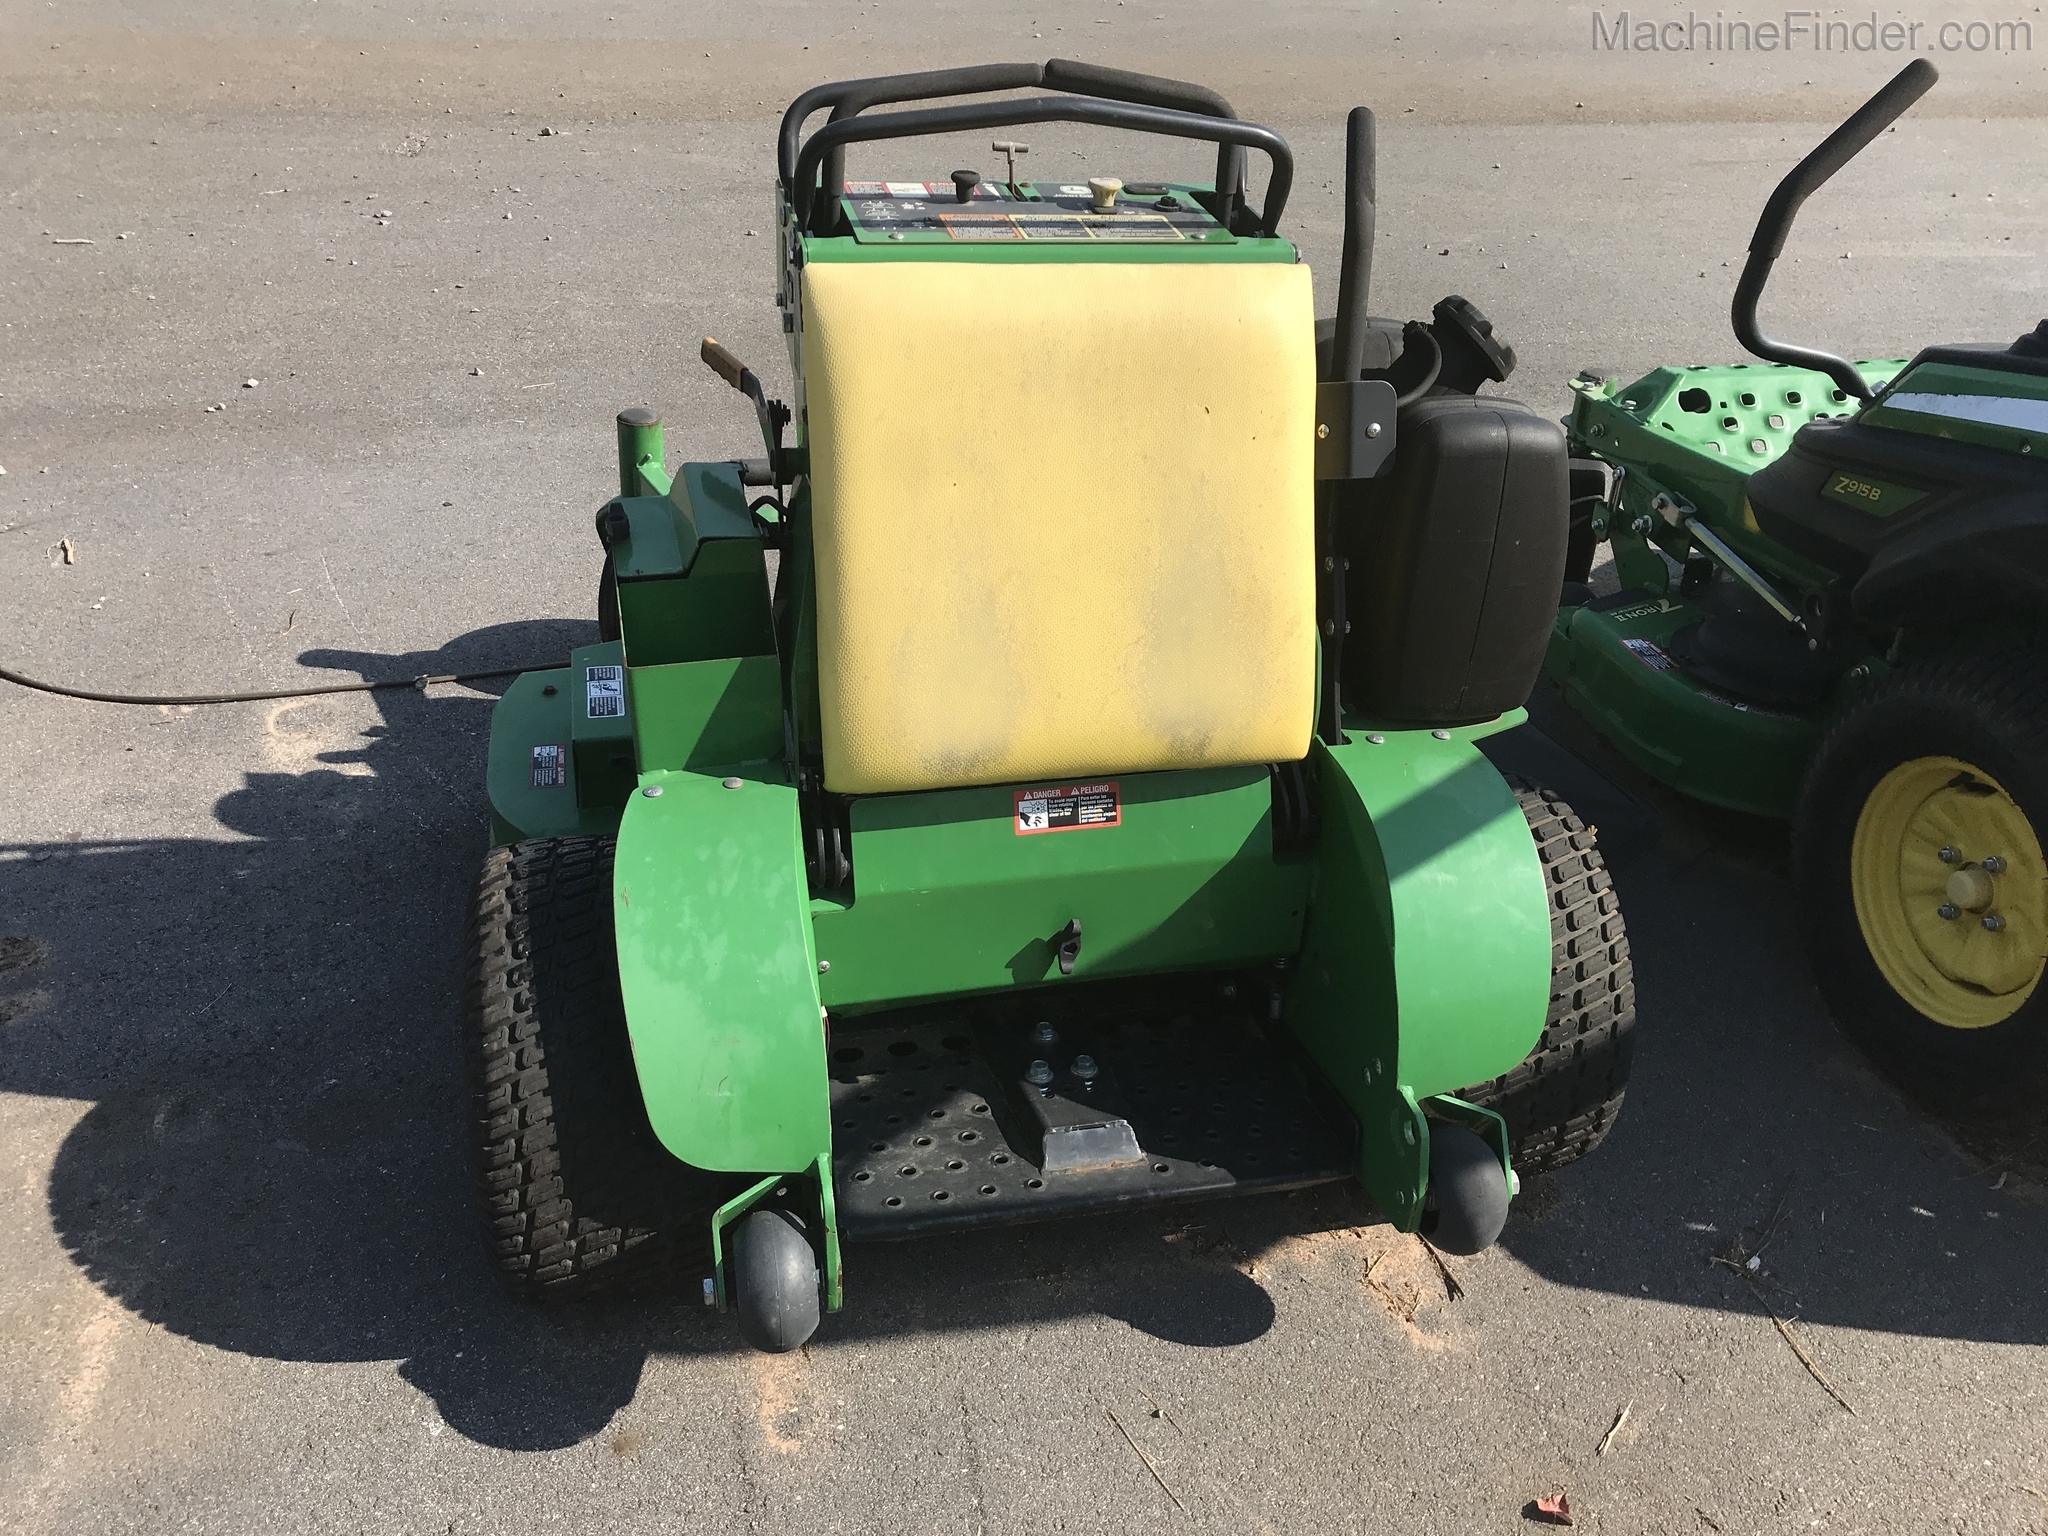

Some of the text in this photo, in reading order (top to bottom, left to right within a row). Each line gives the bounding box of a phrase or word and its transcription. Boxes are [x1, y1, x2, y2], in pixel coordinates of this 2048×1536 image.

[1834, 476, 1881, 501] Z915B
[1033, 789, 1061, 799] DANGER
[1080, 784, 1109, 795] PELIGRO
